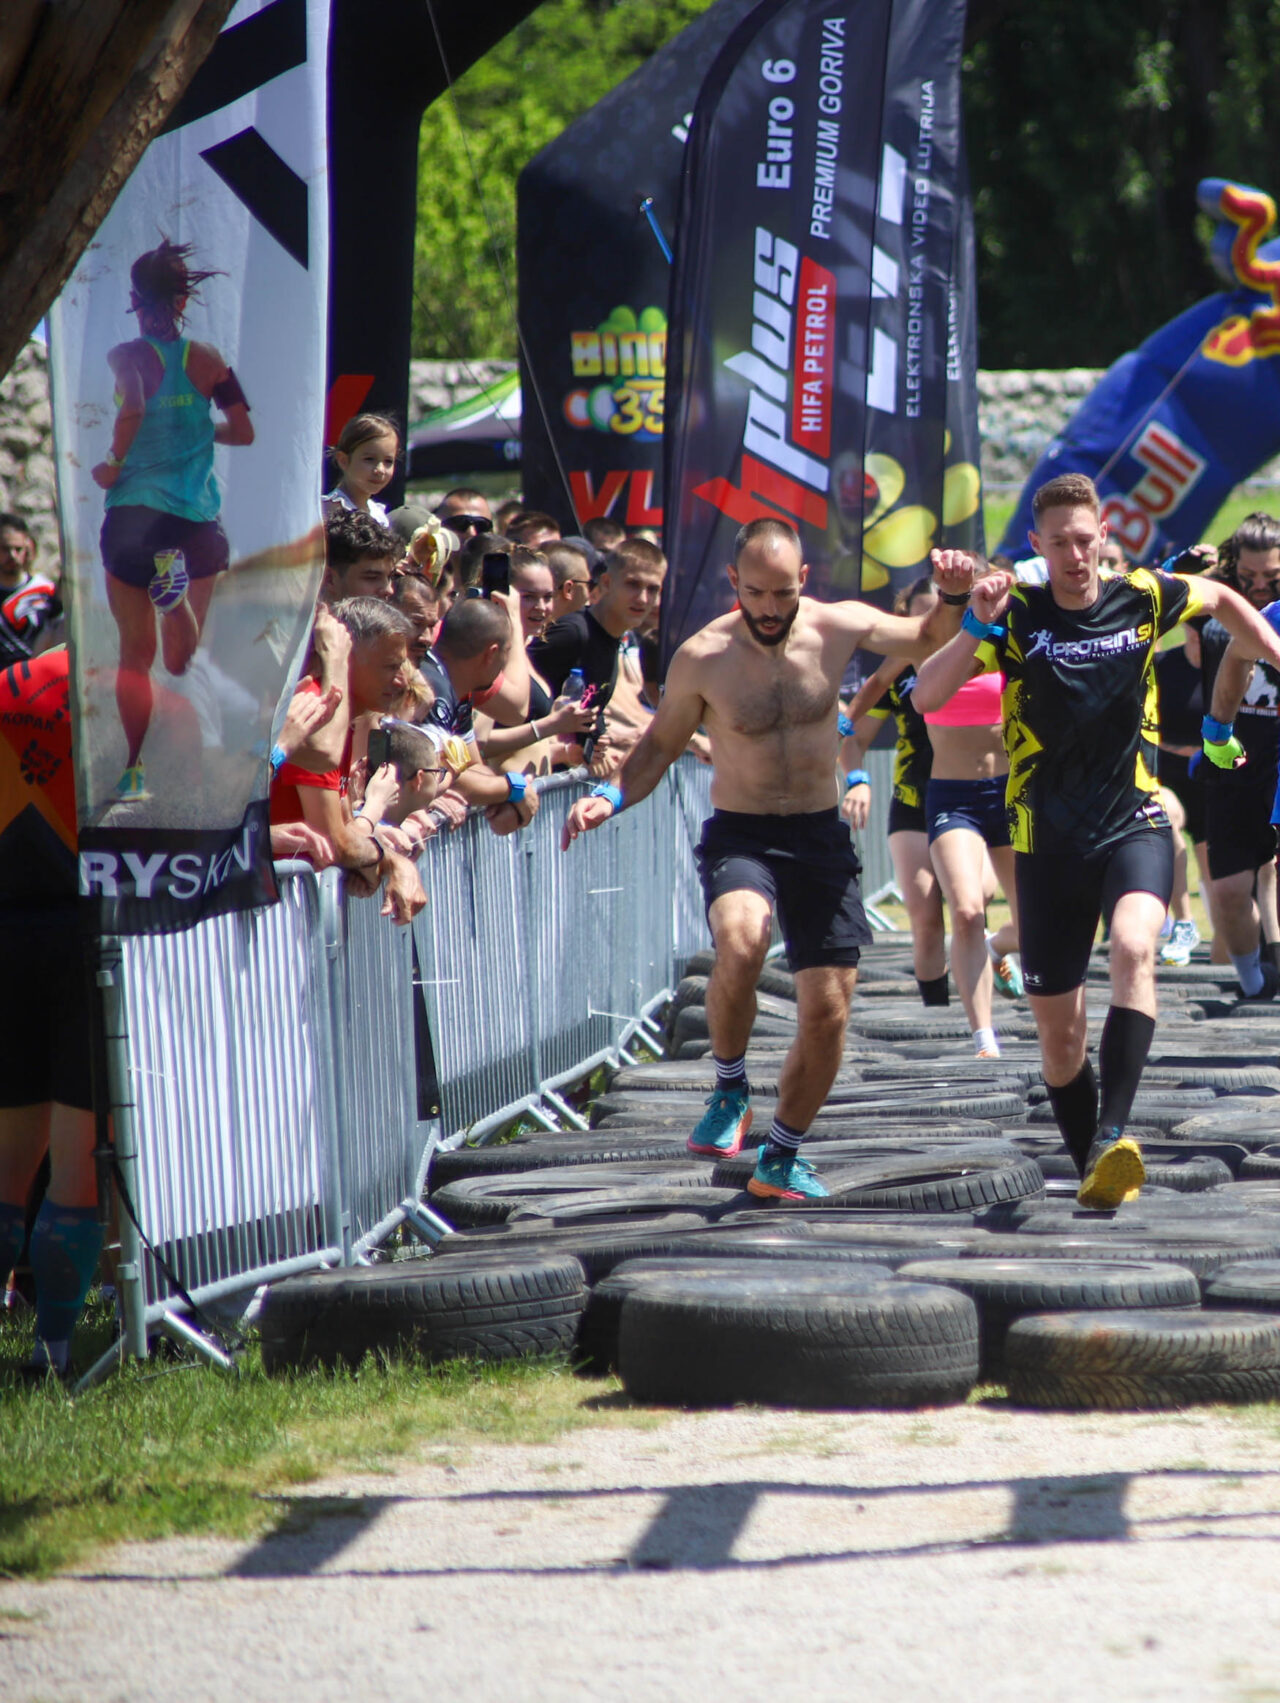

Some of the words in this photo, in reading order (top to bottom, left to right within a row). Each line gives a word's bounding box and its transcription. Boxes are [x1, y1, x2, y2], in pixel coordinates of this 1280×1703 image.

[761, 58, 797, 84] 6
[818, 17, 846, 115] GORIVA
[757, 96, 794, 189] Euro
[917, 79, 936, 170] LUTRIJA
[810, 120, 840, 240] PREMIUM
[911, 178, 931, 247] VIDEO
[804, 284, 828, 373] PETROL
[906, 253, 926, 418] ELEKTRONSKA
[801, 380, 823, 432] HIFA
[1100, 422, 1205, 560] Bull
